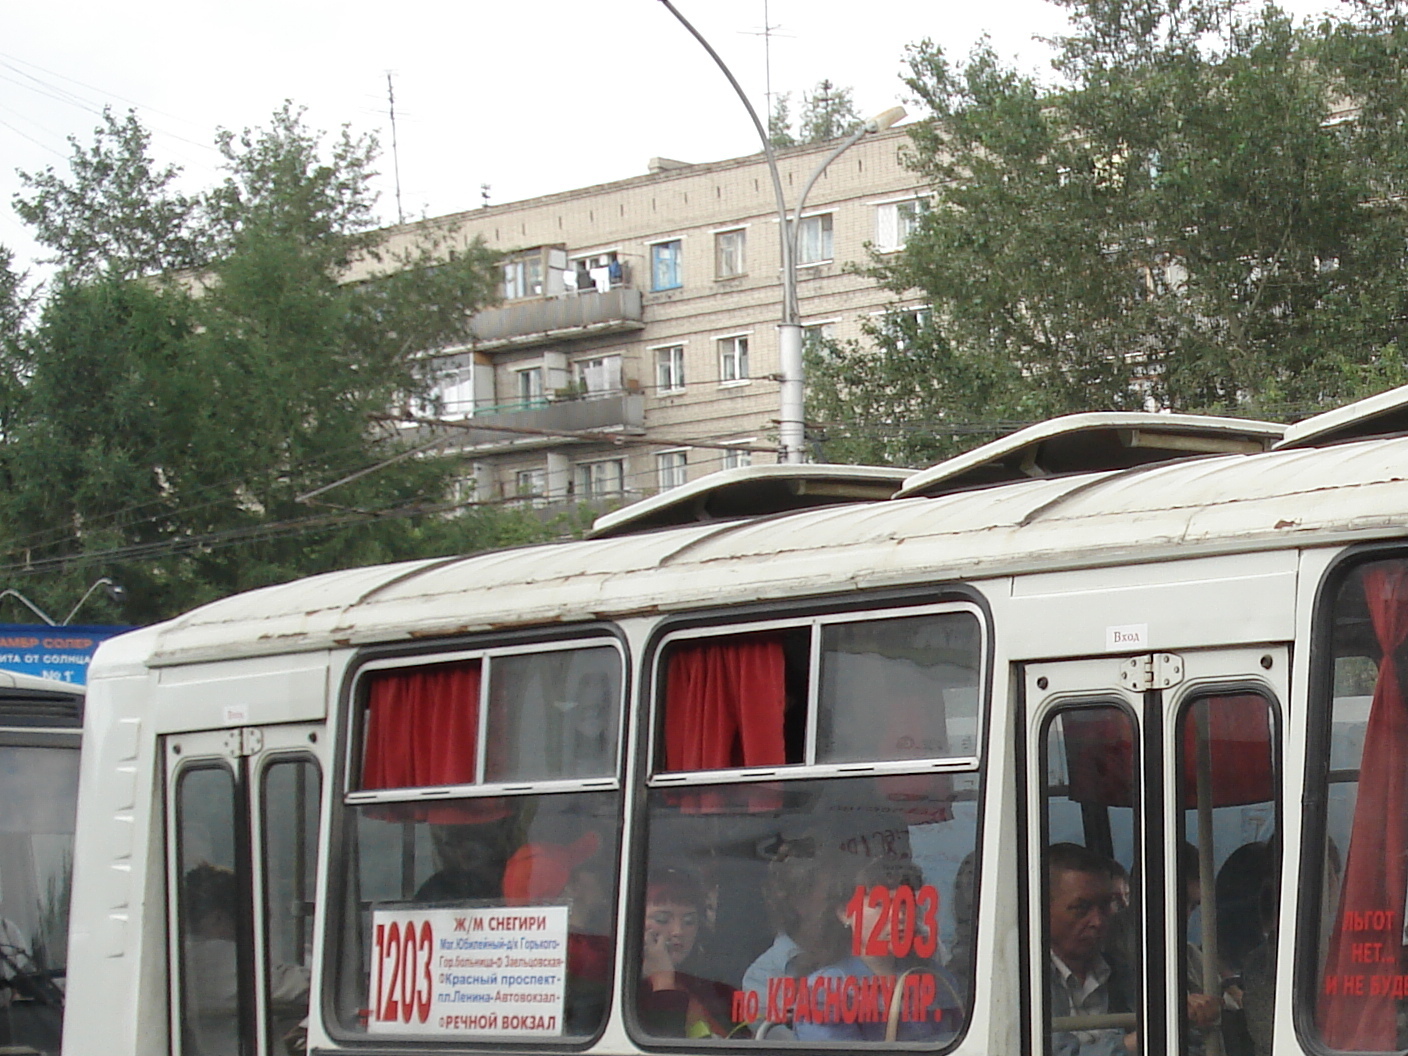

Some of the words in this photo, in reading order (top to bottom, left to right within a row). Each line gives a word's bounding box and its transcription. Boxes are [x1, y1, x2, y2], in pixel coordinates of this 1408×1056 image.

[1113, 631, 1140, 644] Вход
[24, 653, 40, 664] ОТ
[42, 653, 91, 665] СОЛНЦА
[454, 916, 484, 935] Ж/М
[488, 915, 546, 932] СНЕГИРИ
[846, 884, 939, 959] 1203
[1342, 911, 1395, 932] ЛЬГОТ
[1352, 942, 1396, 964] НЕТ...
[375, 920, 434, 1024] 1203
[445, 973, 497, 988] Красный
[501, 975, 561, 988] проспект-
[1324, 975, 1337, 995] И
[1343, 974, 1365, 996] НЕ
[731, 990, 759, 1024] по
[766, 975, 897, 1024] КРАСНОМУ
[902, 972, 943, 1023] ПР.
[445, 1012, 497, 1030] РЕЧНОЙ
[501, 1015, 556, 1030] ВОКЗАЛ
